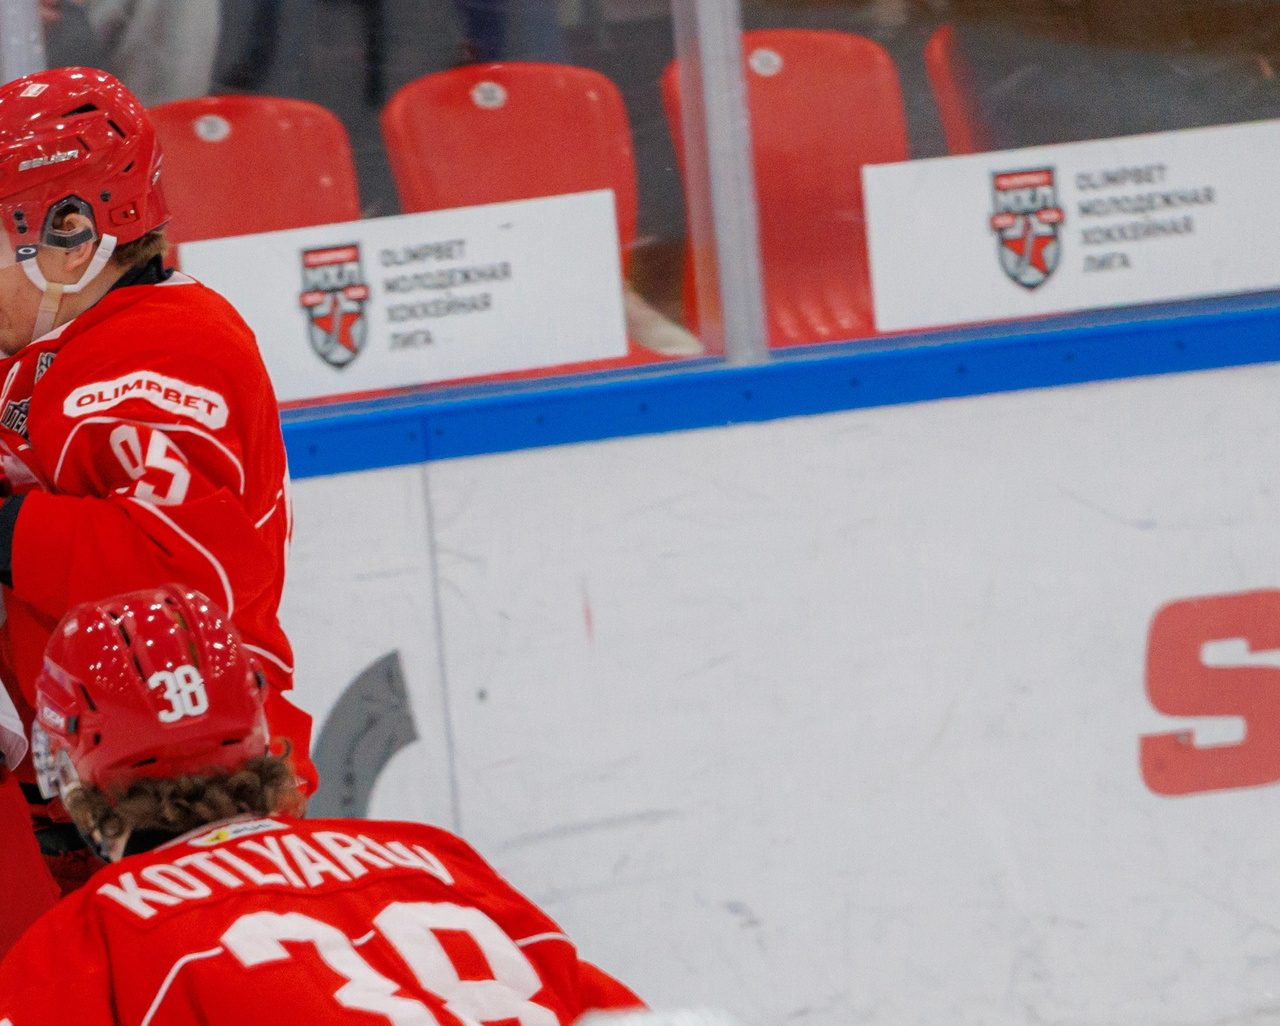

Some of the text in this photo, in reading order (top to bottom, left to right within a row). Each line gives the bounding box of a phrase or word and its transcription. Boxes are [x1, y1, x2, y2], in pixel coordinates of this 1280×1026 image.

[18, 149, 79, 172] BAUER
[1076, 163, 1166, 190] OLIMPBET
[381, 239, 465, 266] OLIMPBET
[75, 379, 219, 415] OLIMPBET
[147, 664, 209, 723] 38
